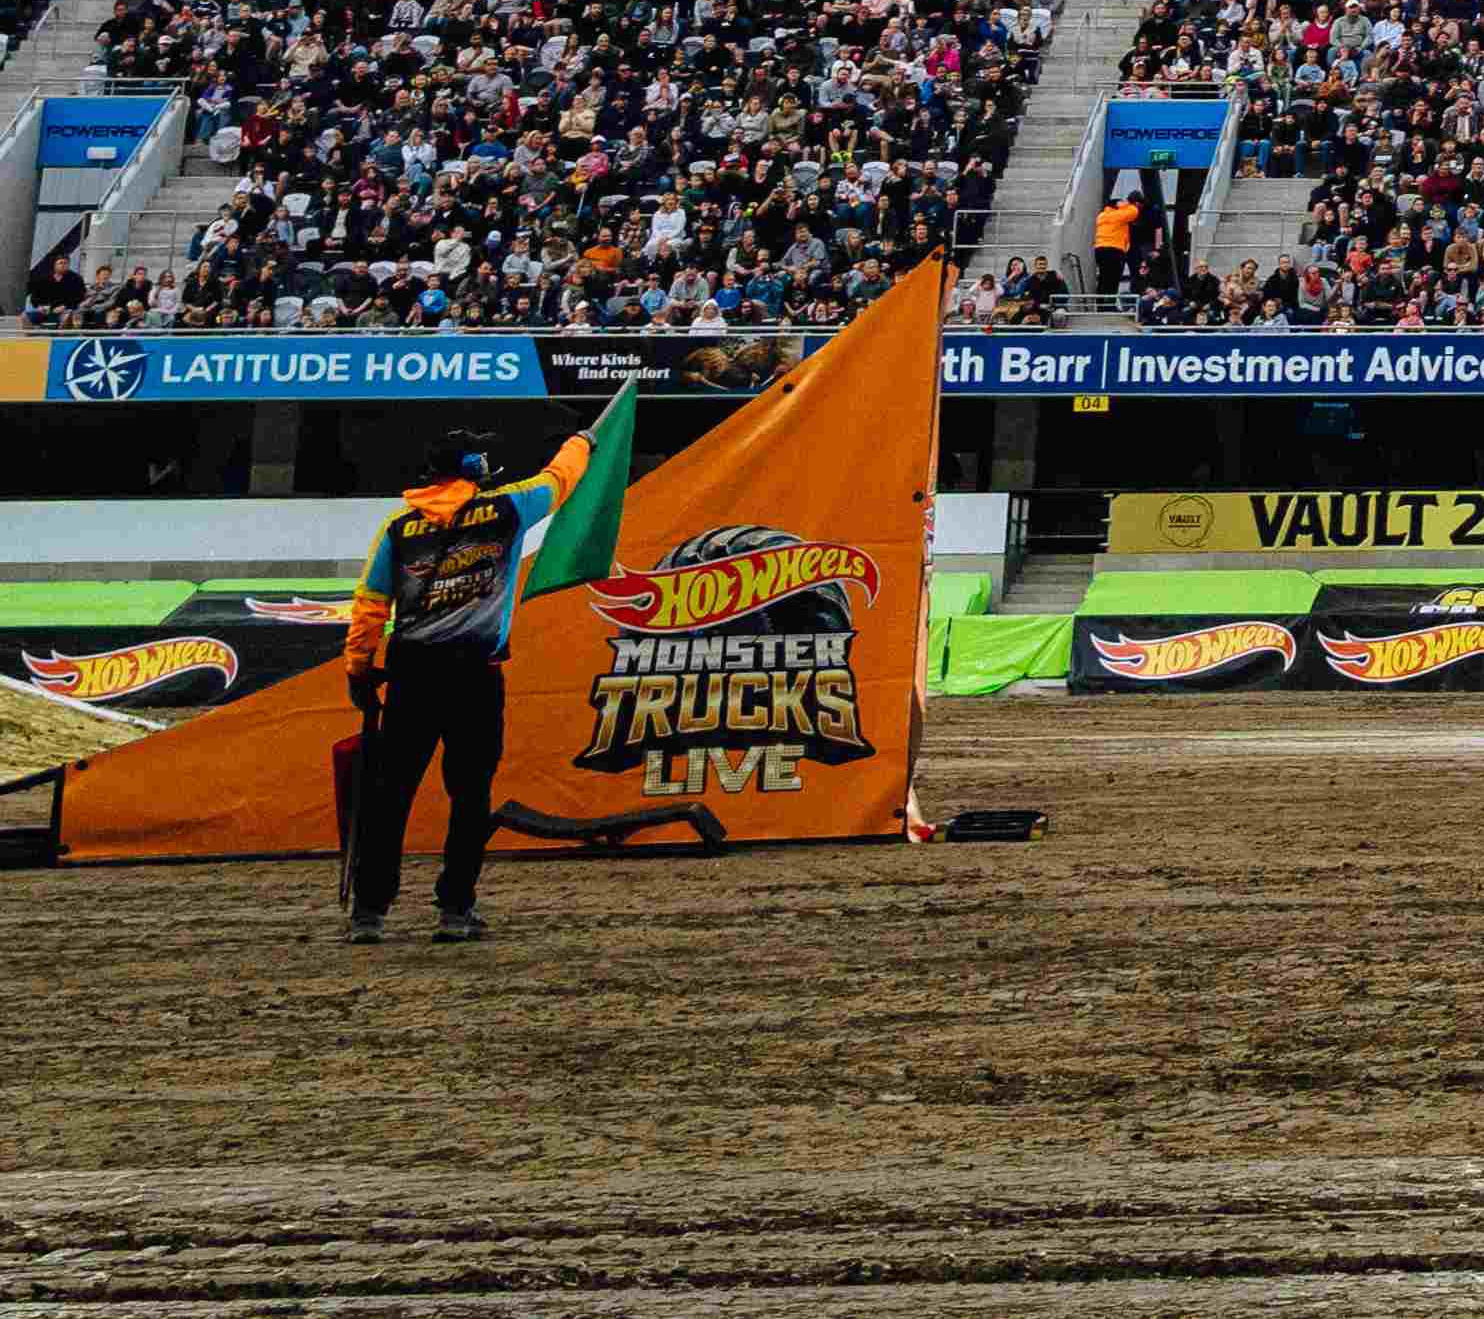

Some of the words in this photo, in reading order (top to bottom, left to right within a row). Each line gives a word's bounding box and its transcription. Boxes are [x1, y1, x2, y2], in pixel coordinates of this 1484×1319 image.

[46, 124, 150, 138] POWERAD
[162, 352, 349, 383] LATITUDE
[364, 350, 521, 382] HOMES
[577, 366, 609, 380] find
[600, 353, 641, 366] Kiwis
[1000, 345, 1092, 382] Barr
[1118, 344, 1352, 382] Investment
[1081, 396, 1101, 411] 04
[1167, 512, 1202, 524] VAULT
[1248, 492, 1440, 549] VAULT
[608, 630, 858, 674] MONSTER
[585, 669, 863, 759] TRUCKS
[642, 744, 807, 796] LIVE
